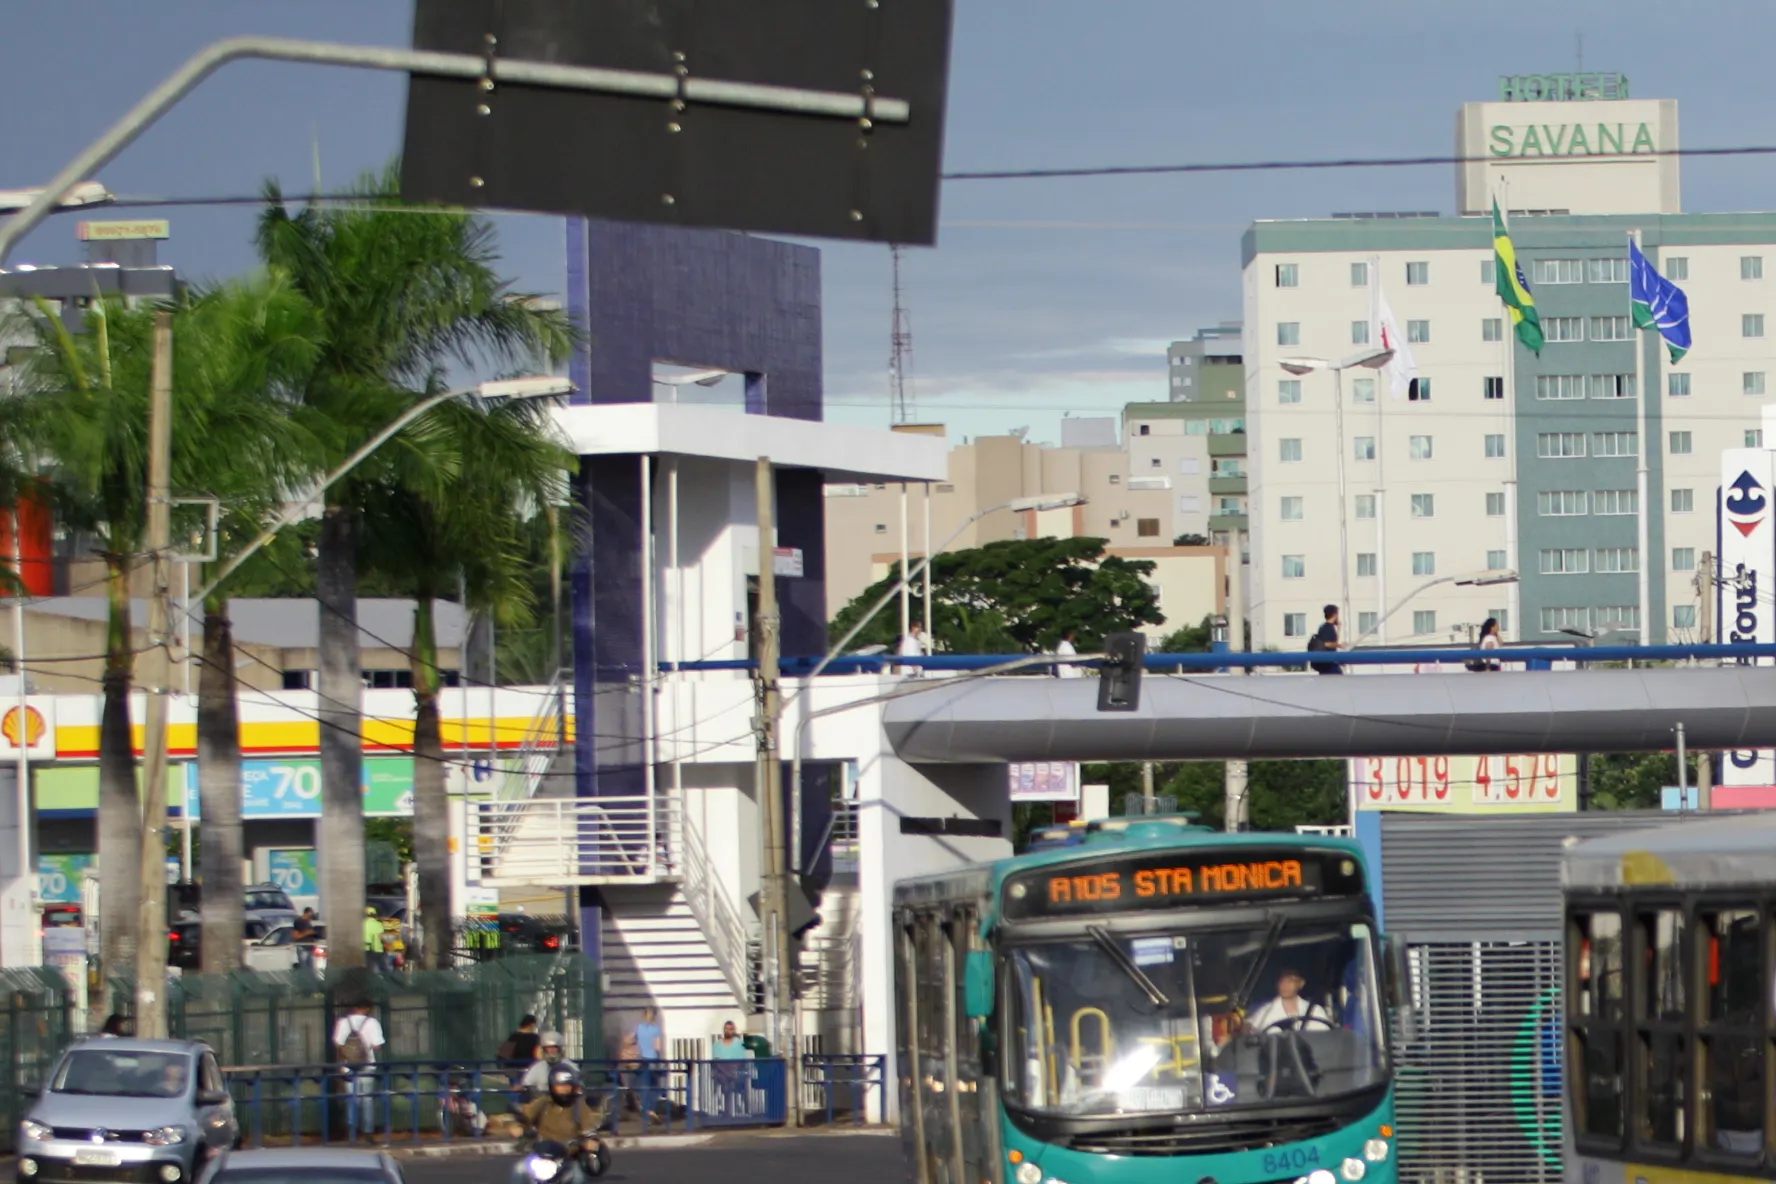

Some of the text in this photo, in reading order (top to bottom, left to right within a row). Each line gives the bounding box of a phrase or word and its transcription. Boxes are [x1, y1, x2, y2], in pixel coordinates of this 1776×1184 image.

[1498, 73, 1618, 101] HOTEL
[1490, 122, 1656, 157] SAVANA
[268, 765, 322, 800] 70
[1049, 859, 1302, 903] A105 STA MONICA
[1263, 1146, 1321, 1174] 8404
